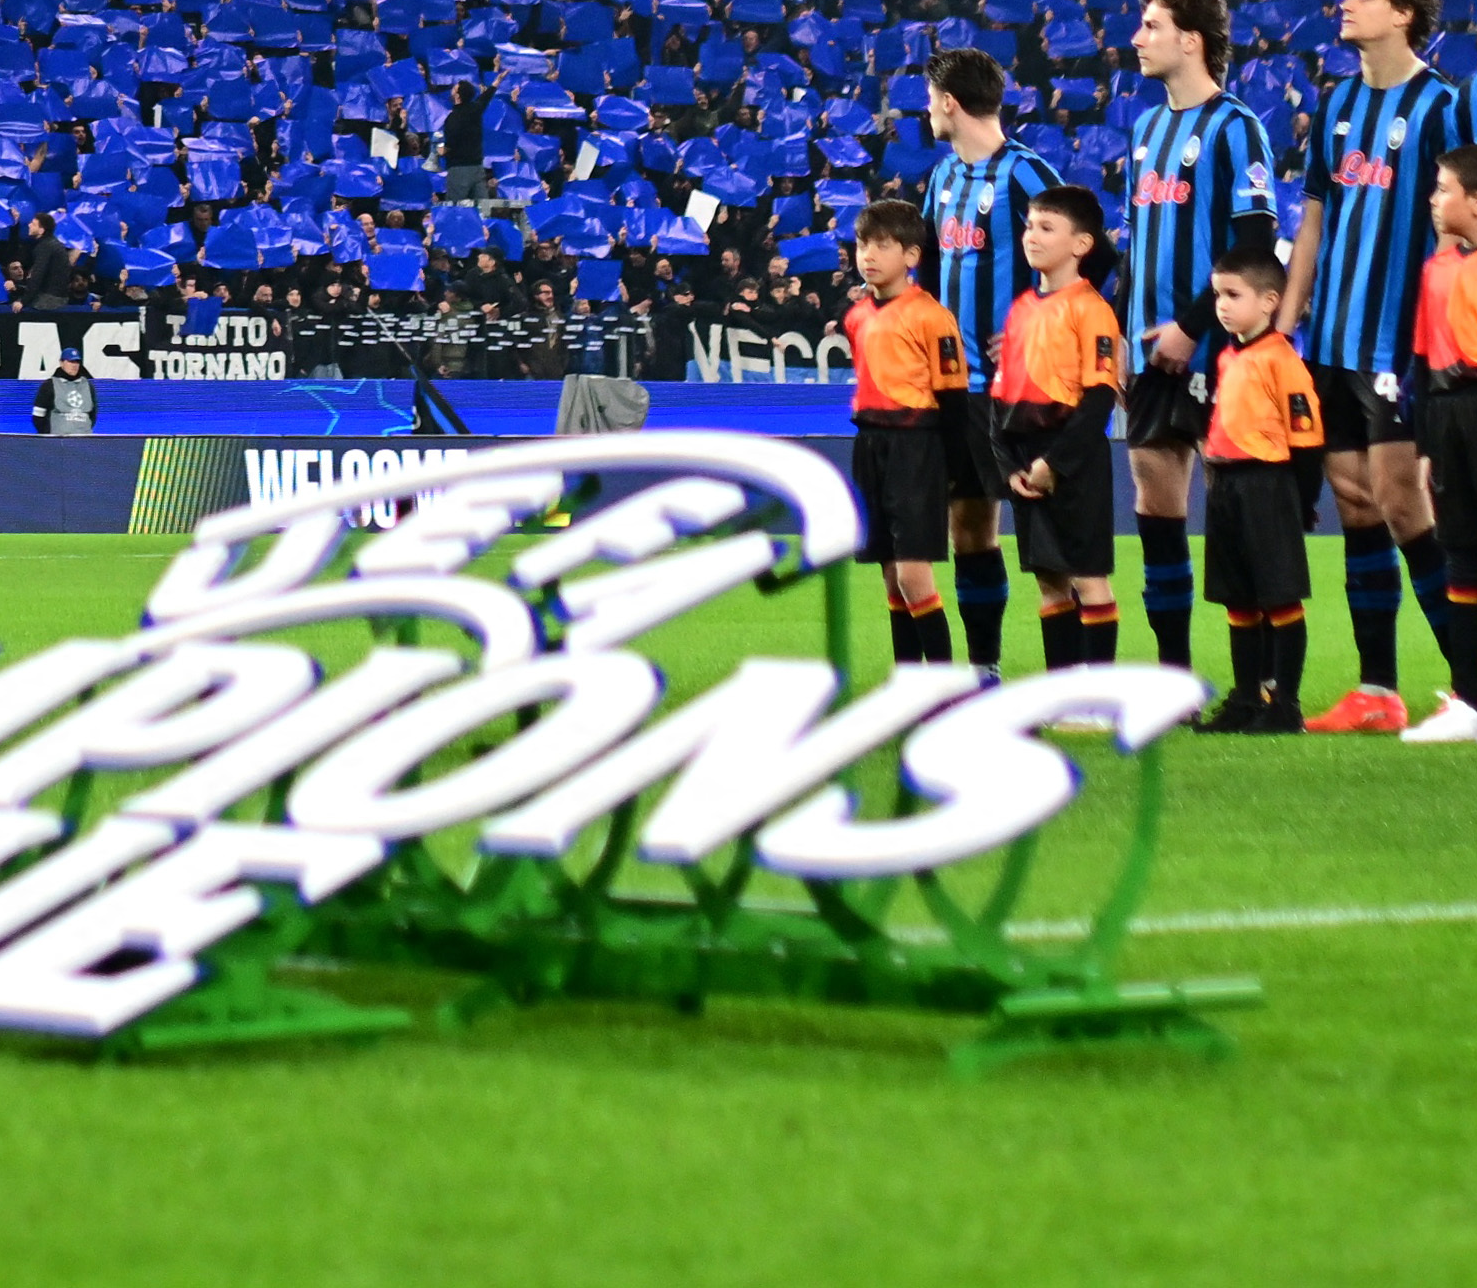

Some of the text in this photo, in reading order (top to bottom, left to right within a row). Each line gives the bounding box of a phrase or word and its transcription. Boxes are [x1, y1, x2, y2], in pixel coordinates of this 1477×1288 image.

[1331, 149, 1393, 189] Lete
[1132, 169, 1192, 206] Lete
[166, 315, 267, 346] TNTO
[149, 351, 286, 380] TORNANO
